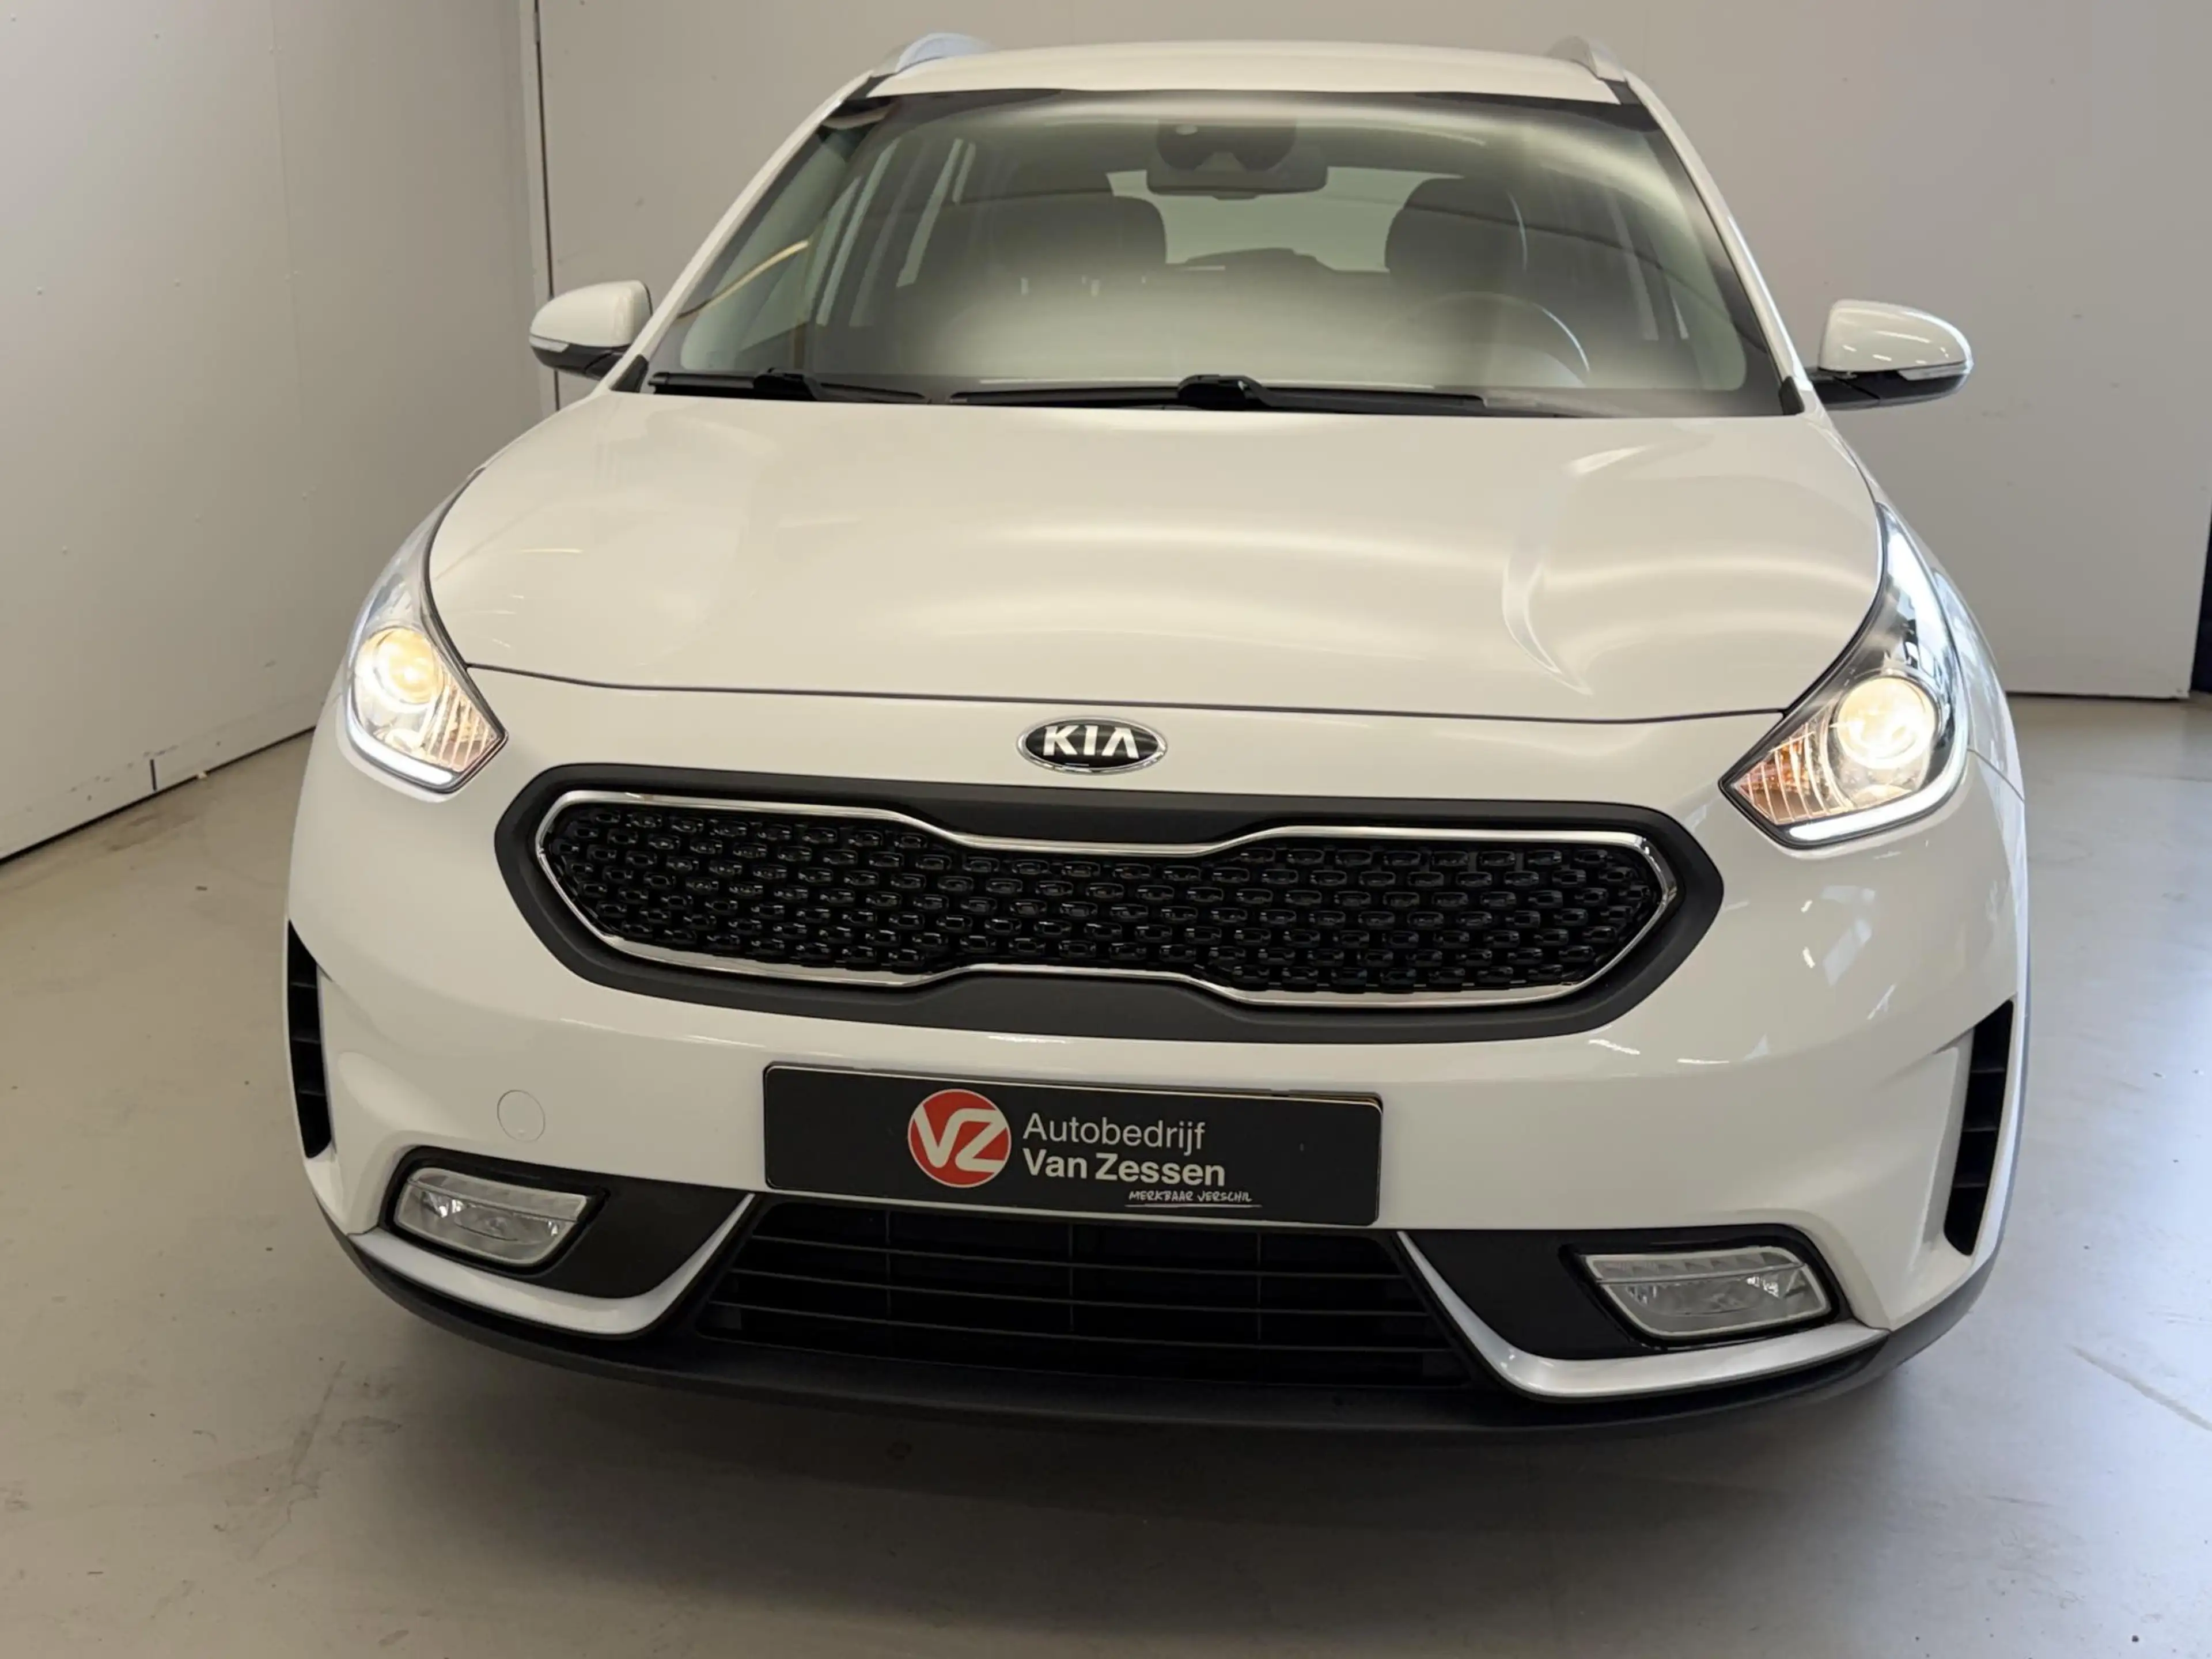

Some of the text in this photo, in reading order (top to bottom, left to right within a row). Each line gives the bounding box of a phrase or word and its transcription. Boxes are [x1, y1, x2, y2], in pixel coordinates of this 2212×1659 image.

[1043, 725, 1140, 759] KIA
[913, 1101, 1008, 1173] VZ
[1022, 1112, 1206, 1157] Autobedrijf
[1022, 1147, 1226, 1187] Van Zessen
[1128, 1190, 1194, 1202] MERKBAAR
